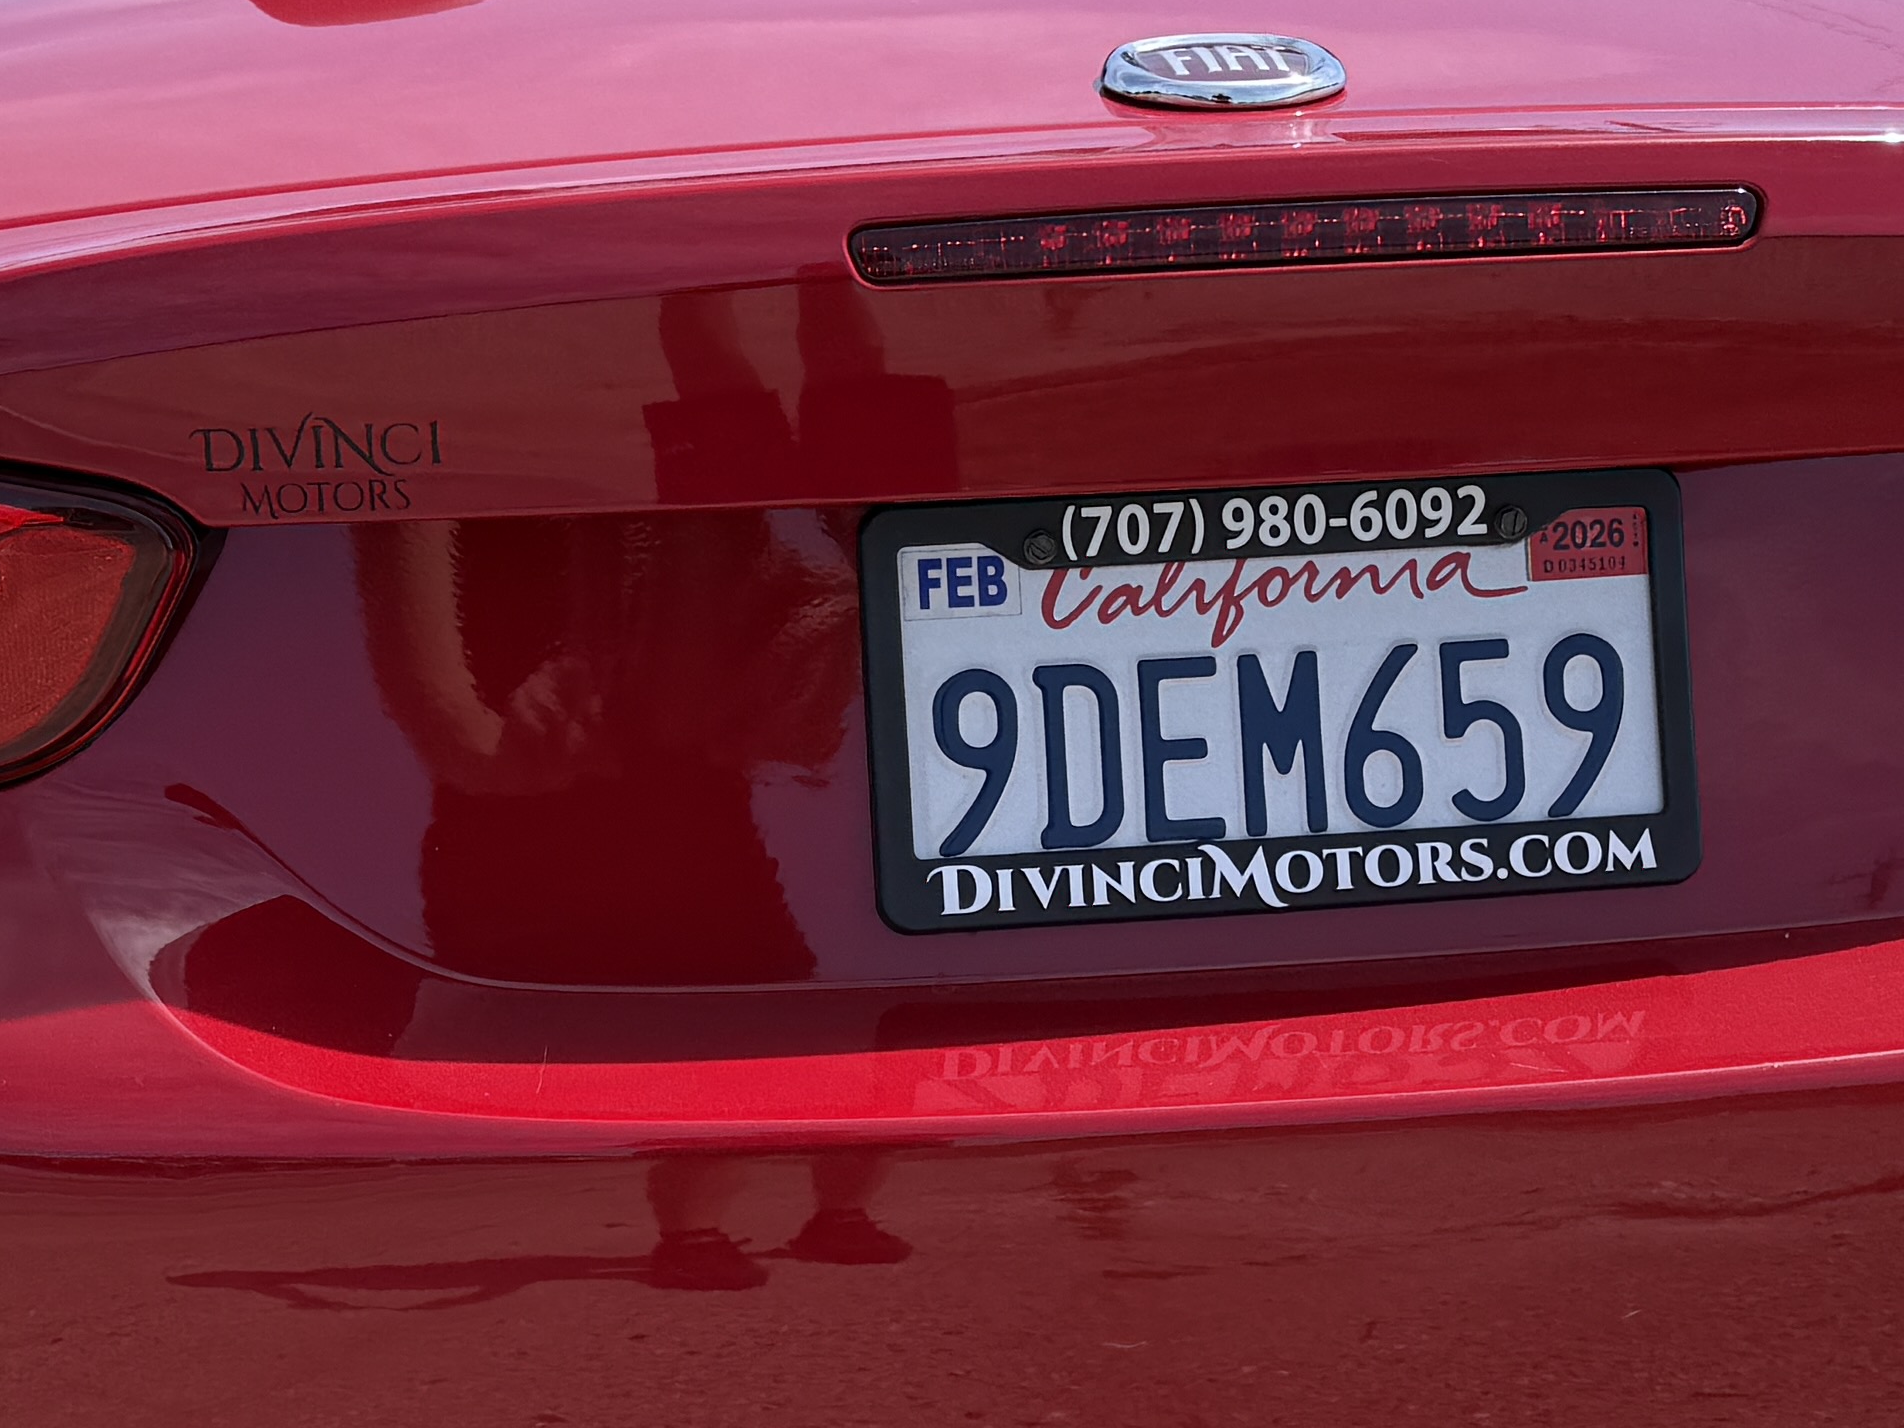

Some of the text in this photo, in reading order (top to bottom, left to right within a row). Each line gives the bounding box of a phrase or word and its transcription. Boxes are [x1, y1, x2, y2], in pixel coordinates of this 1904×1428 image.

[1162, 44, 1291, 77] FIAT
[189, 411, 442, 476] DIVINCI
[240, 478, 412, 519] MOTORS
[1061, 484, 1488, 561] (707) 980-6092
[1553, 518, 1625, 551] 2026
[917, 554, 1009, 610] FEB
[1041, 551, 1528, 648] California
[932, 631, 1626, 858] 9DEM659
